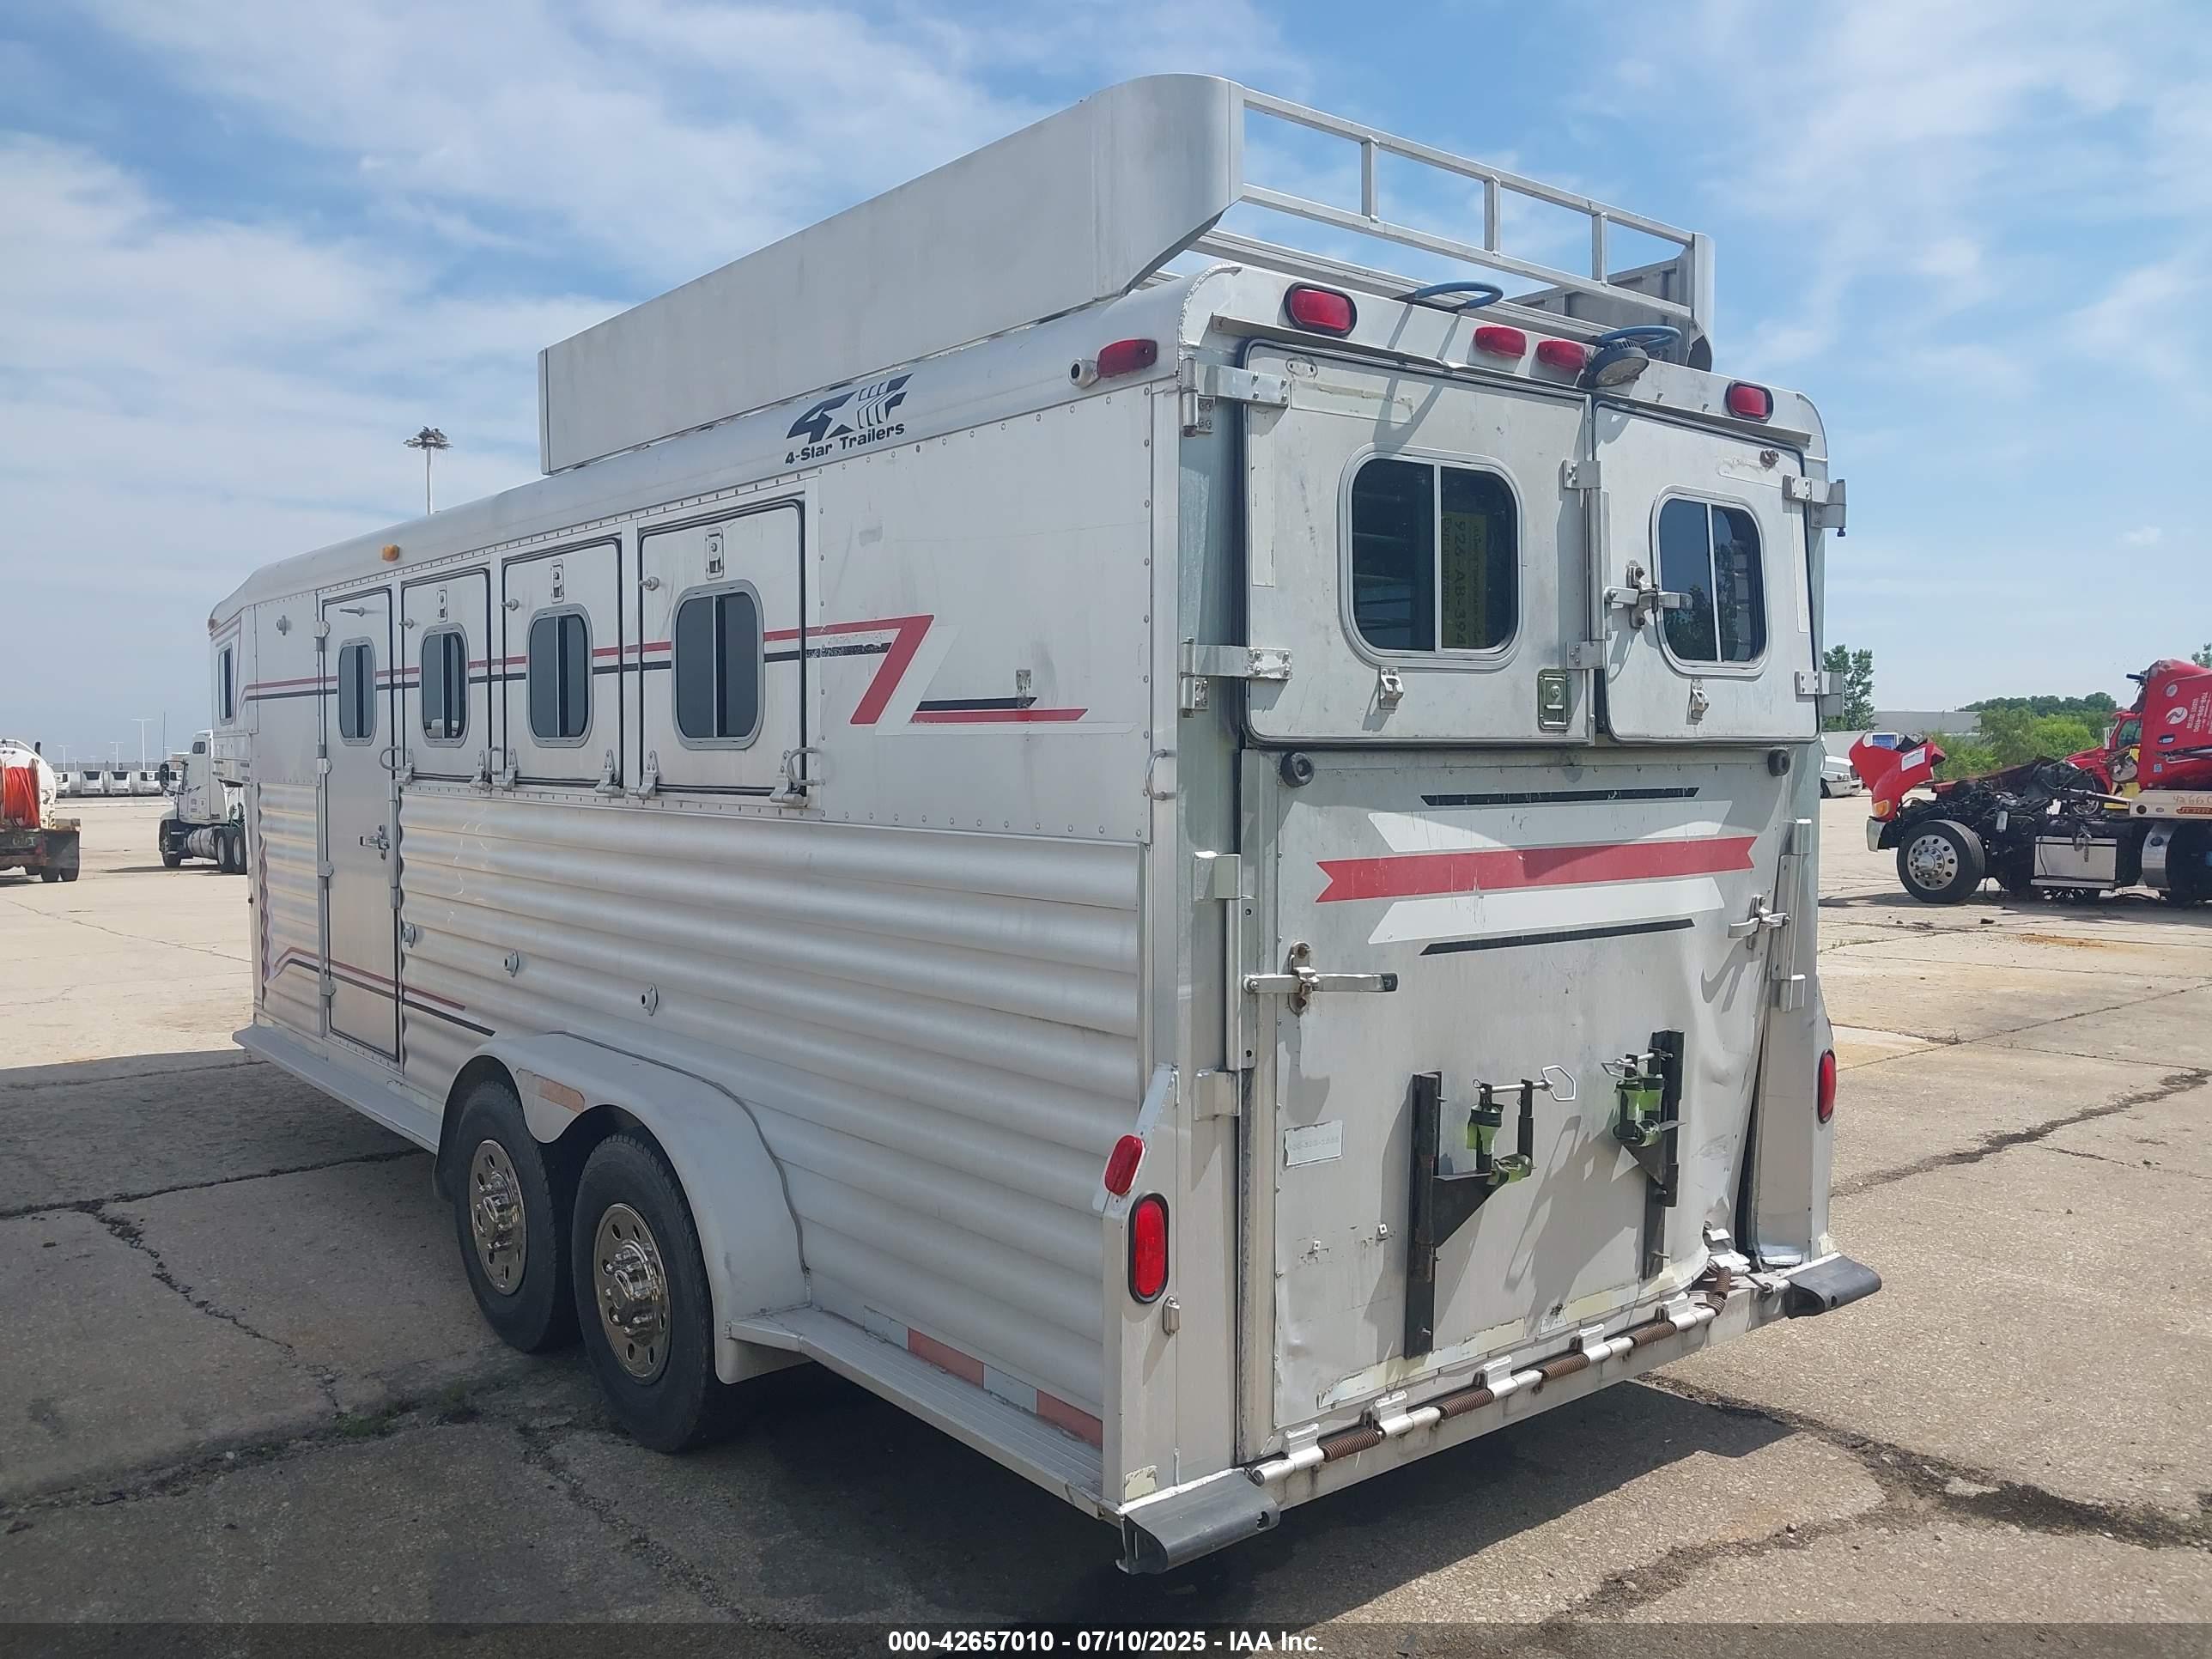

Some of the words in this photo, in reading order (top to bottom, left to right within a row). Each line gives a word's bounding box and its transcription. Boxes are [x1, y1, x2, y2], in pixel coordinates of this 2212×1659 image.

[785, 443, 833, 465] 4-Star
[839, 422, 905, 451] Trailers
[1454, 520, 1467, 645] 926-AB-394
